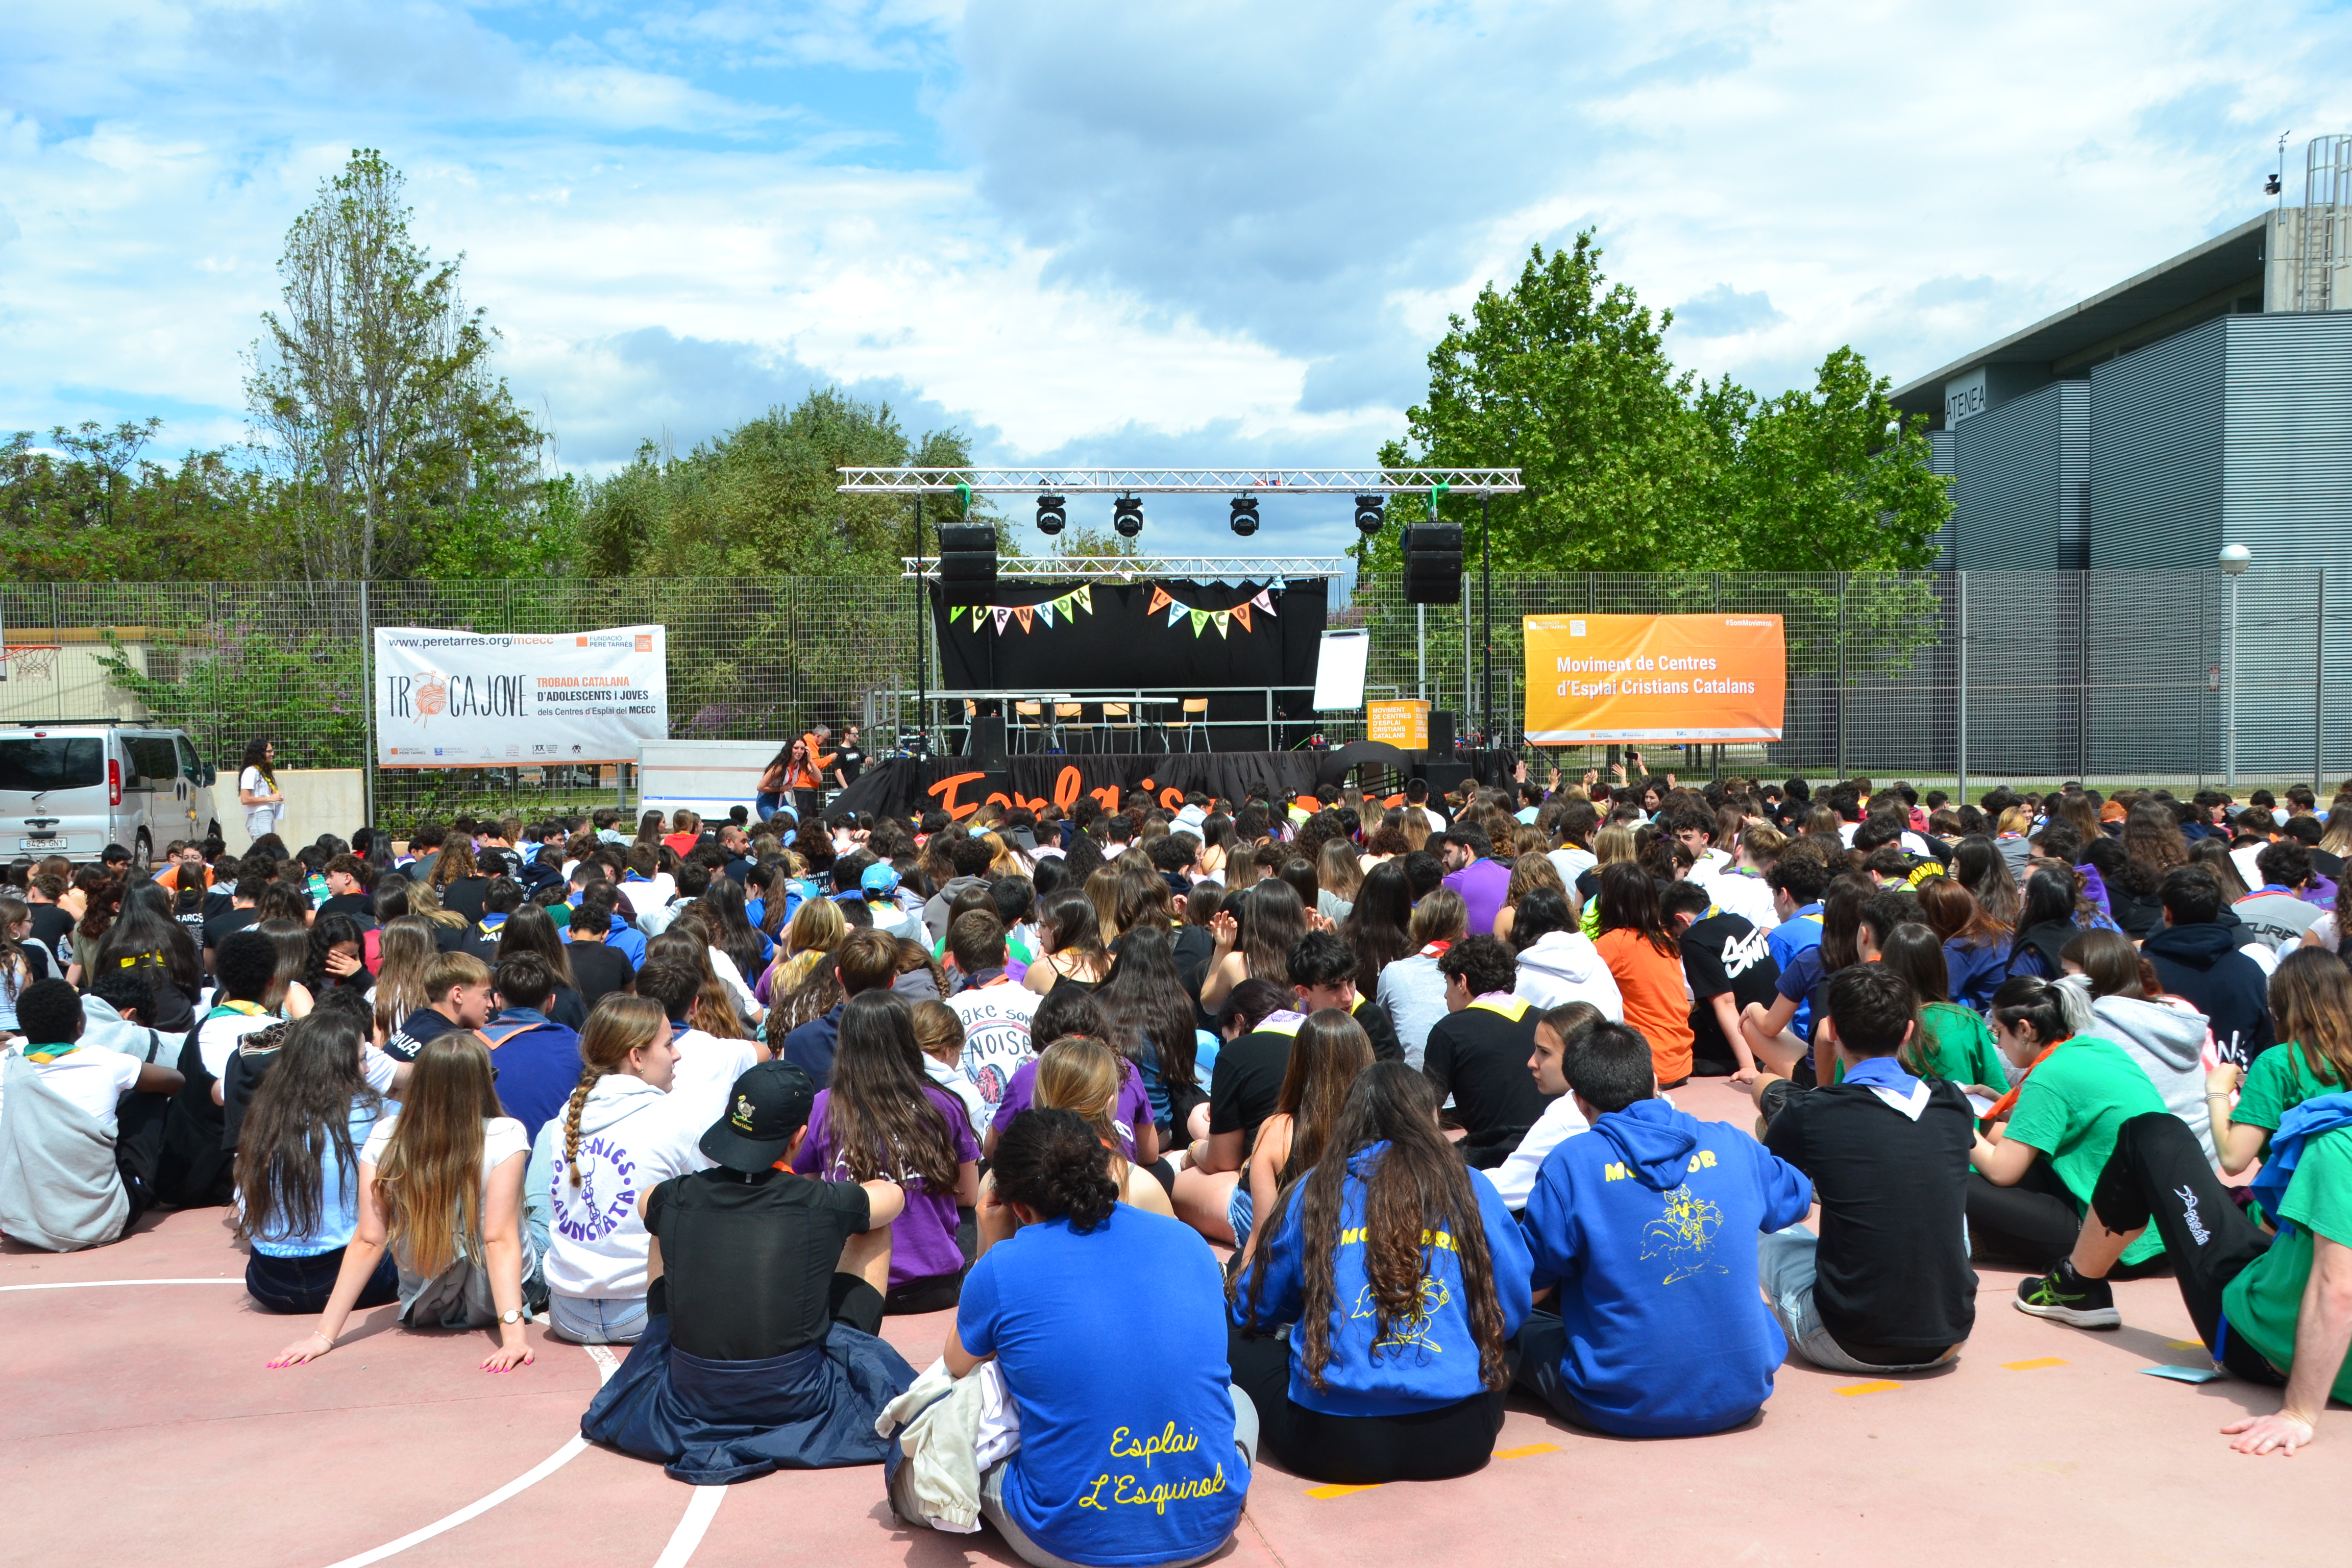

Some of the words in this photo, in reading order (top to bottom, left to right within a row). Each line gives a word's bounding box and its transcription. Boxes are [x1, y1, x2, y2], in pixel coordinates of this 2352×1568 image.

[1945, 385, 1985, 423] ATENEA
[955, 590, 1089, 623] ORNADA
[1153, 578, 1279, 621] L'ESCOL
[389, 635, 553, 649] www.peretarres.org/mcecc
[1557, 656, 1632, 672] Moviment
[1636, 655, 1654, 671] de
[1658, 655, 1717, 670] Centres
[536, 677, 580, 688] TROBADA
[582, 676, 629, 687] CATALANA
[1557, 679, 1616, 699] d'Esplai
[1622, 678, 1689, 694] Cristians
[1693, 677, 1755, 694] Catalans
[537, 691, 611, 701] D'ADOLESCENTS
[620, 690, 649, 700] JOVES
[585, 706, 614, 717] d'Esplai
[616, 706, 627, 715] del
[629, 705, 656, 714] MCECC
[182, 913, 204, 923] ARCS
[1110, 1421, 1198, 1468] Esplai
[1079, 1462, 1226, 1515] L'Esquirol
